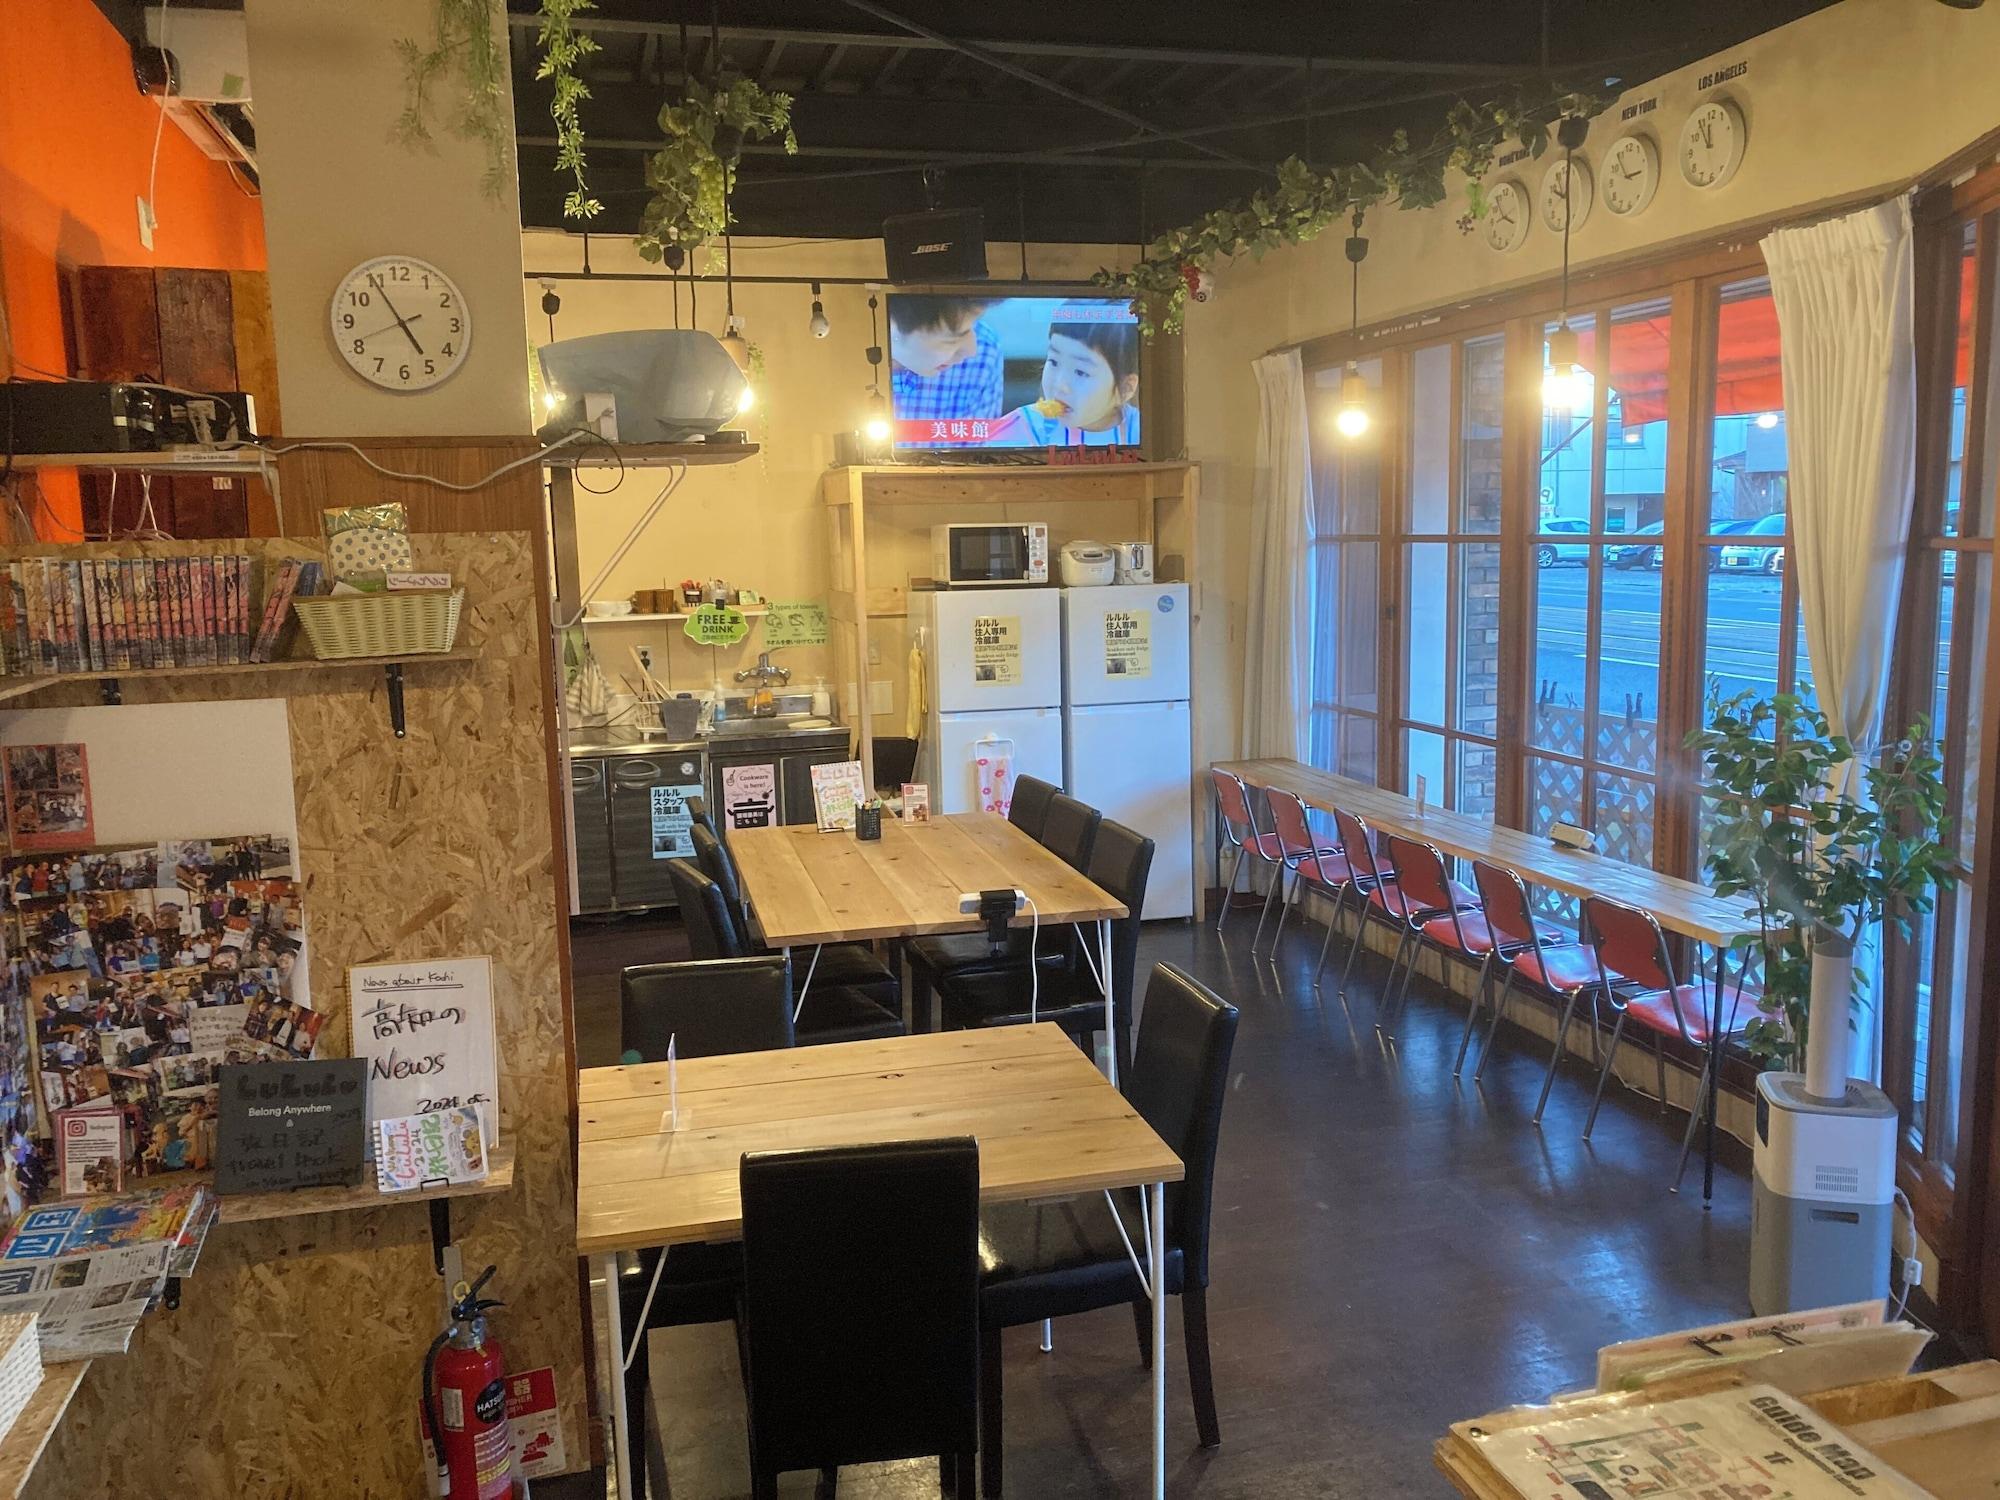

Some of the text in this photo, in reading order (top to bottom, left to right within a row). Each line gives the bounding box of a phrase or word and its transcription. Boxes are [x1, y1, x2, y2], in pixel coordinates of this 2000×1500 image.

[1697, 61, 1748, 91] LOS ANGELES
[1621, 98, 1658, 121] NEW YORK
[1707, 110, 1716, 121] 12
[1691, 132, 1700, 143] 10
[911, 242, 953, 254] BOSE
[366, 273, 385, 288] 11
[389, 266, 410, 281] 12
[421, 275, 429, 290] 1
[348, 292, 370, 307] 10
[439, 293, 451, 308] 2
[343, 314, 355, 329] 9
[450, 318, 460, 333] 3
[353, 339, 365, 355] 8
[441, 343, 453, 357] 4
[373, 358, 385, 373] 7
[399, 365, 410, 380] 6
[424, 360, 435, 375] 5
[930, 421, 989, 439] 美味館
[768, 602, 774, 610] 3
[697, 614, 726, 625] FREE
[974, 619, 999, 627] ルルル
[1106, 613, 1130, 622] ルルル
[702, 626, 735, 634] DRINK
[974, 627, 1007, 637] 住人専用
[1106, 621, 1138, 630] 住人専用
[653, 789, 681, 797] ルルル
[653, 797, 685, 806] スタッフ
[392, 973, 425, 987] about
[361, 998, 467, 1040] 高知の
[371, 1047, 447, 1081] News
[248, 1103, 332, 1118] Belong Anywhere
[1750, 1396, 1822, 1443] Guide
[1812, 1443, 1876, 1480] Map
[1763, 1450, 1794, 1465] 1F
